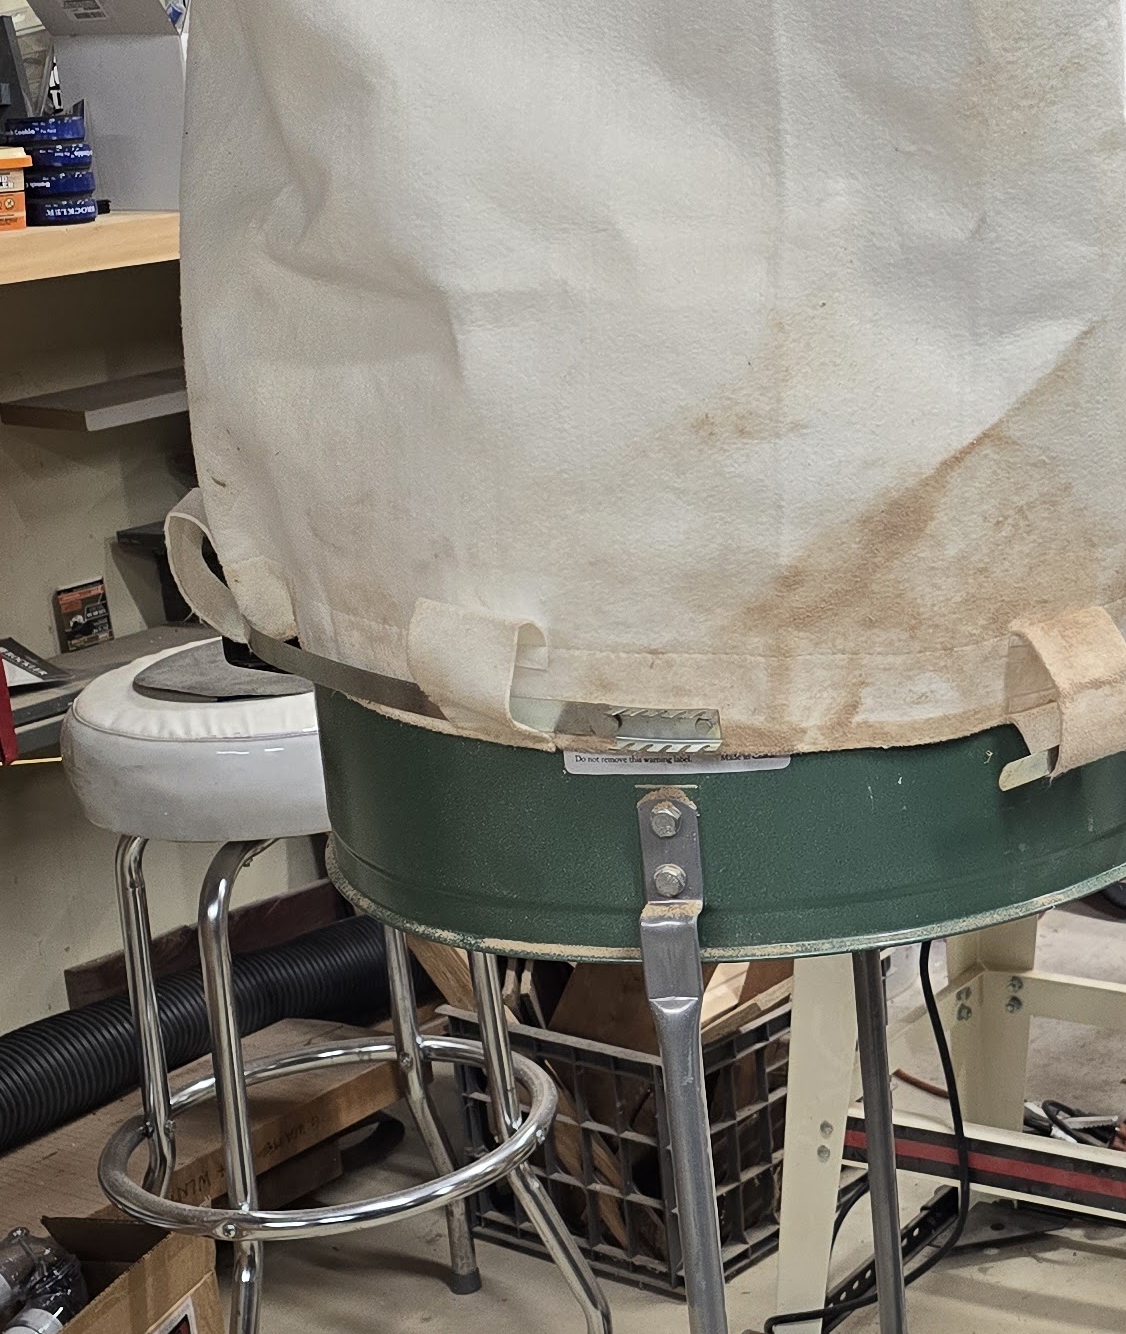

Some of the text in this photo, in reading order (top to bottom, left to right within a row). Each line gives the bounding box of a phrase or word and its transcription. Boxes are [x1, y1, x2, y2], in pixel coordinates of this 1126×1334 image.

[575, 755, 586, 763] Do
[629, 755, 642, 763] this
[643, 755, 672, 764] warning
